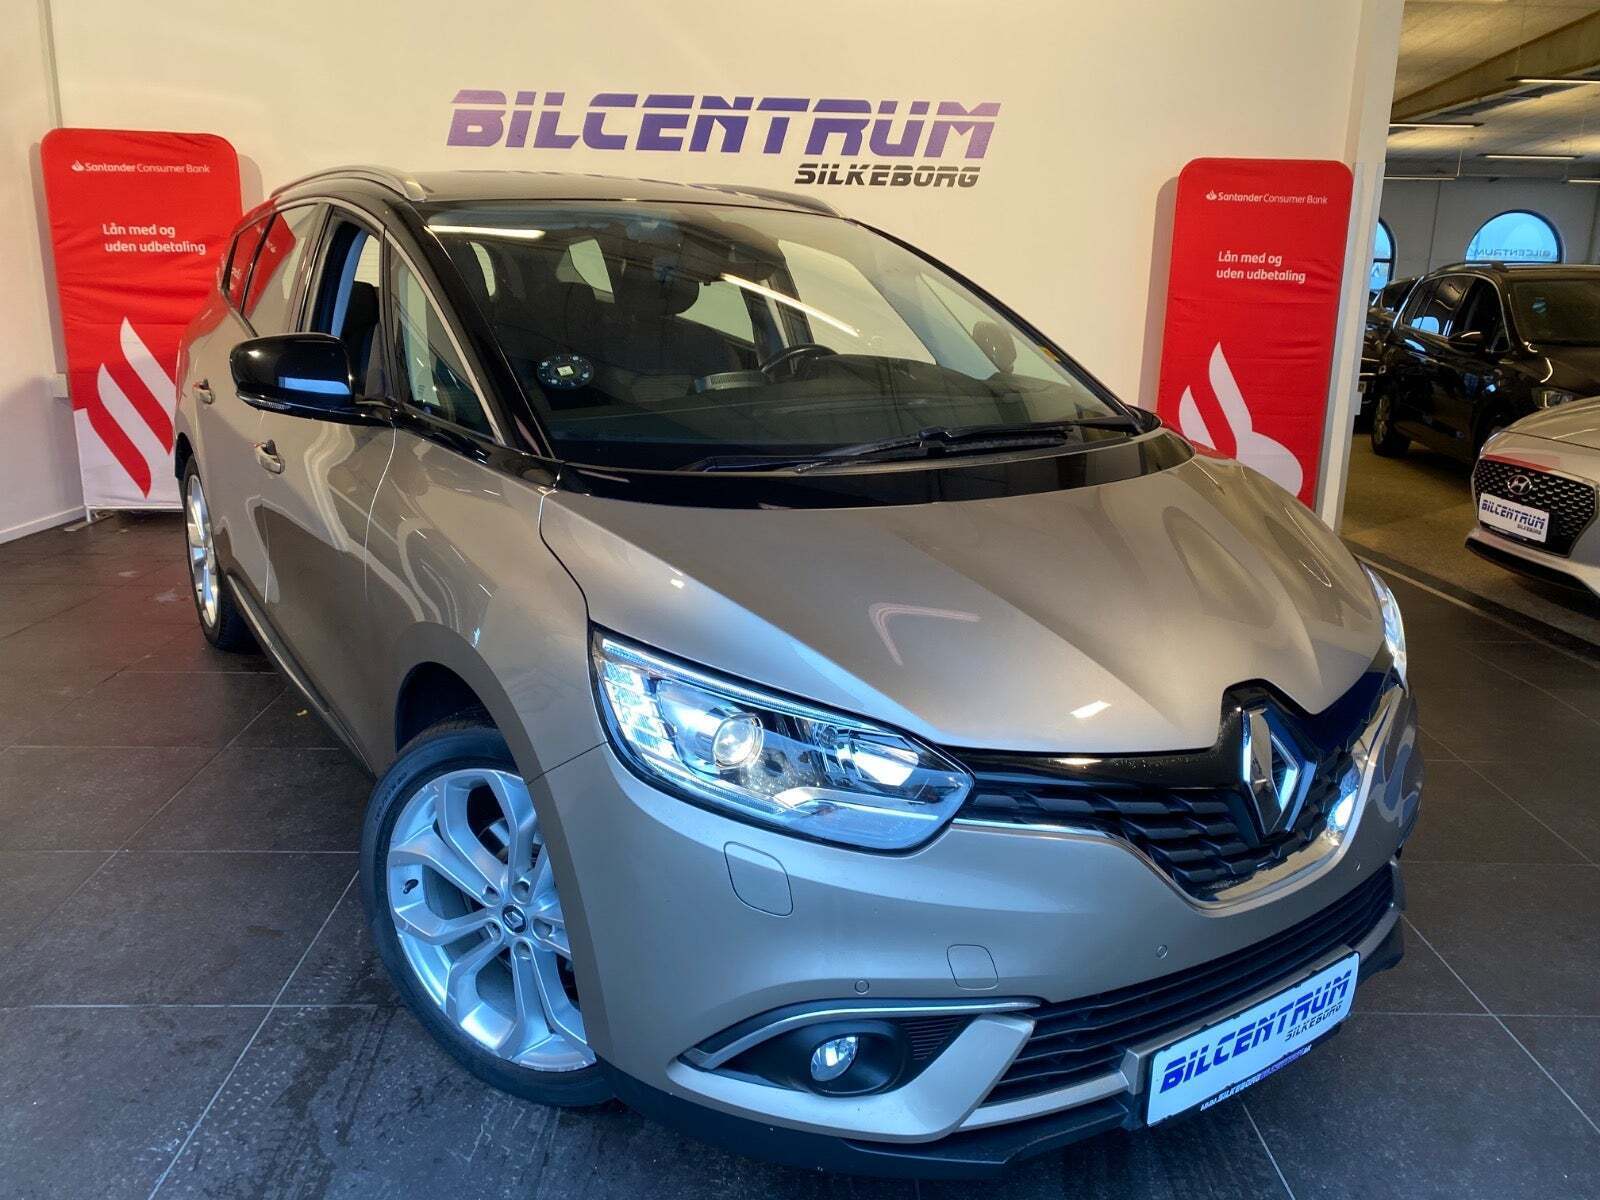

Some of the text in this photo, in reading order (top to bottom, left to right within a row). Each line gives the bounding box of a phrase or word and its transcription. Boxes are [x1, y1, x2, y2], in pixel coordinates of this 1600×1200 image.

[446, 89, 1002, 159] BILCENTRUM
[84, 161, 210, 174] Santander Consumer Bank
[794, 163, 982, 188] SILKEBORG
[1218, 191, 1328, 205] Santander Consumer Bank
[102, 222, 176, 239] Lån med og
[105, 240, 207, 256] uden udbetaling
[1218, 250, 1283, 267] Lån med og
[1216, 267, 1306, 284] uden udbetaling
[1481, 499, 1546, 530] BILCENTRUM
[1284, 1000, 1343, 1042] SILKEBORG
[1159, 969, 1352, 1094] BILCENTRUM
